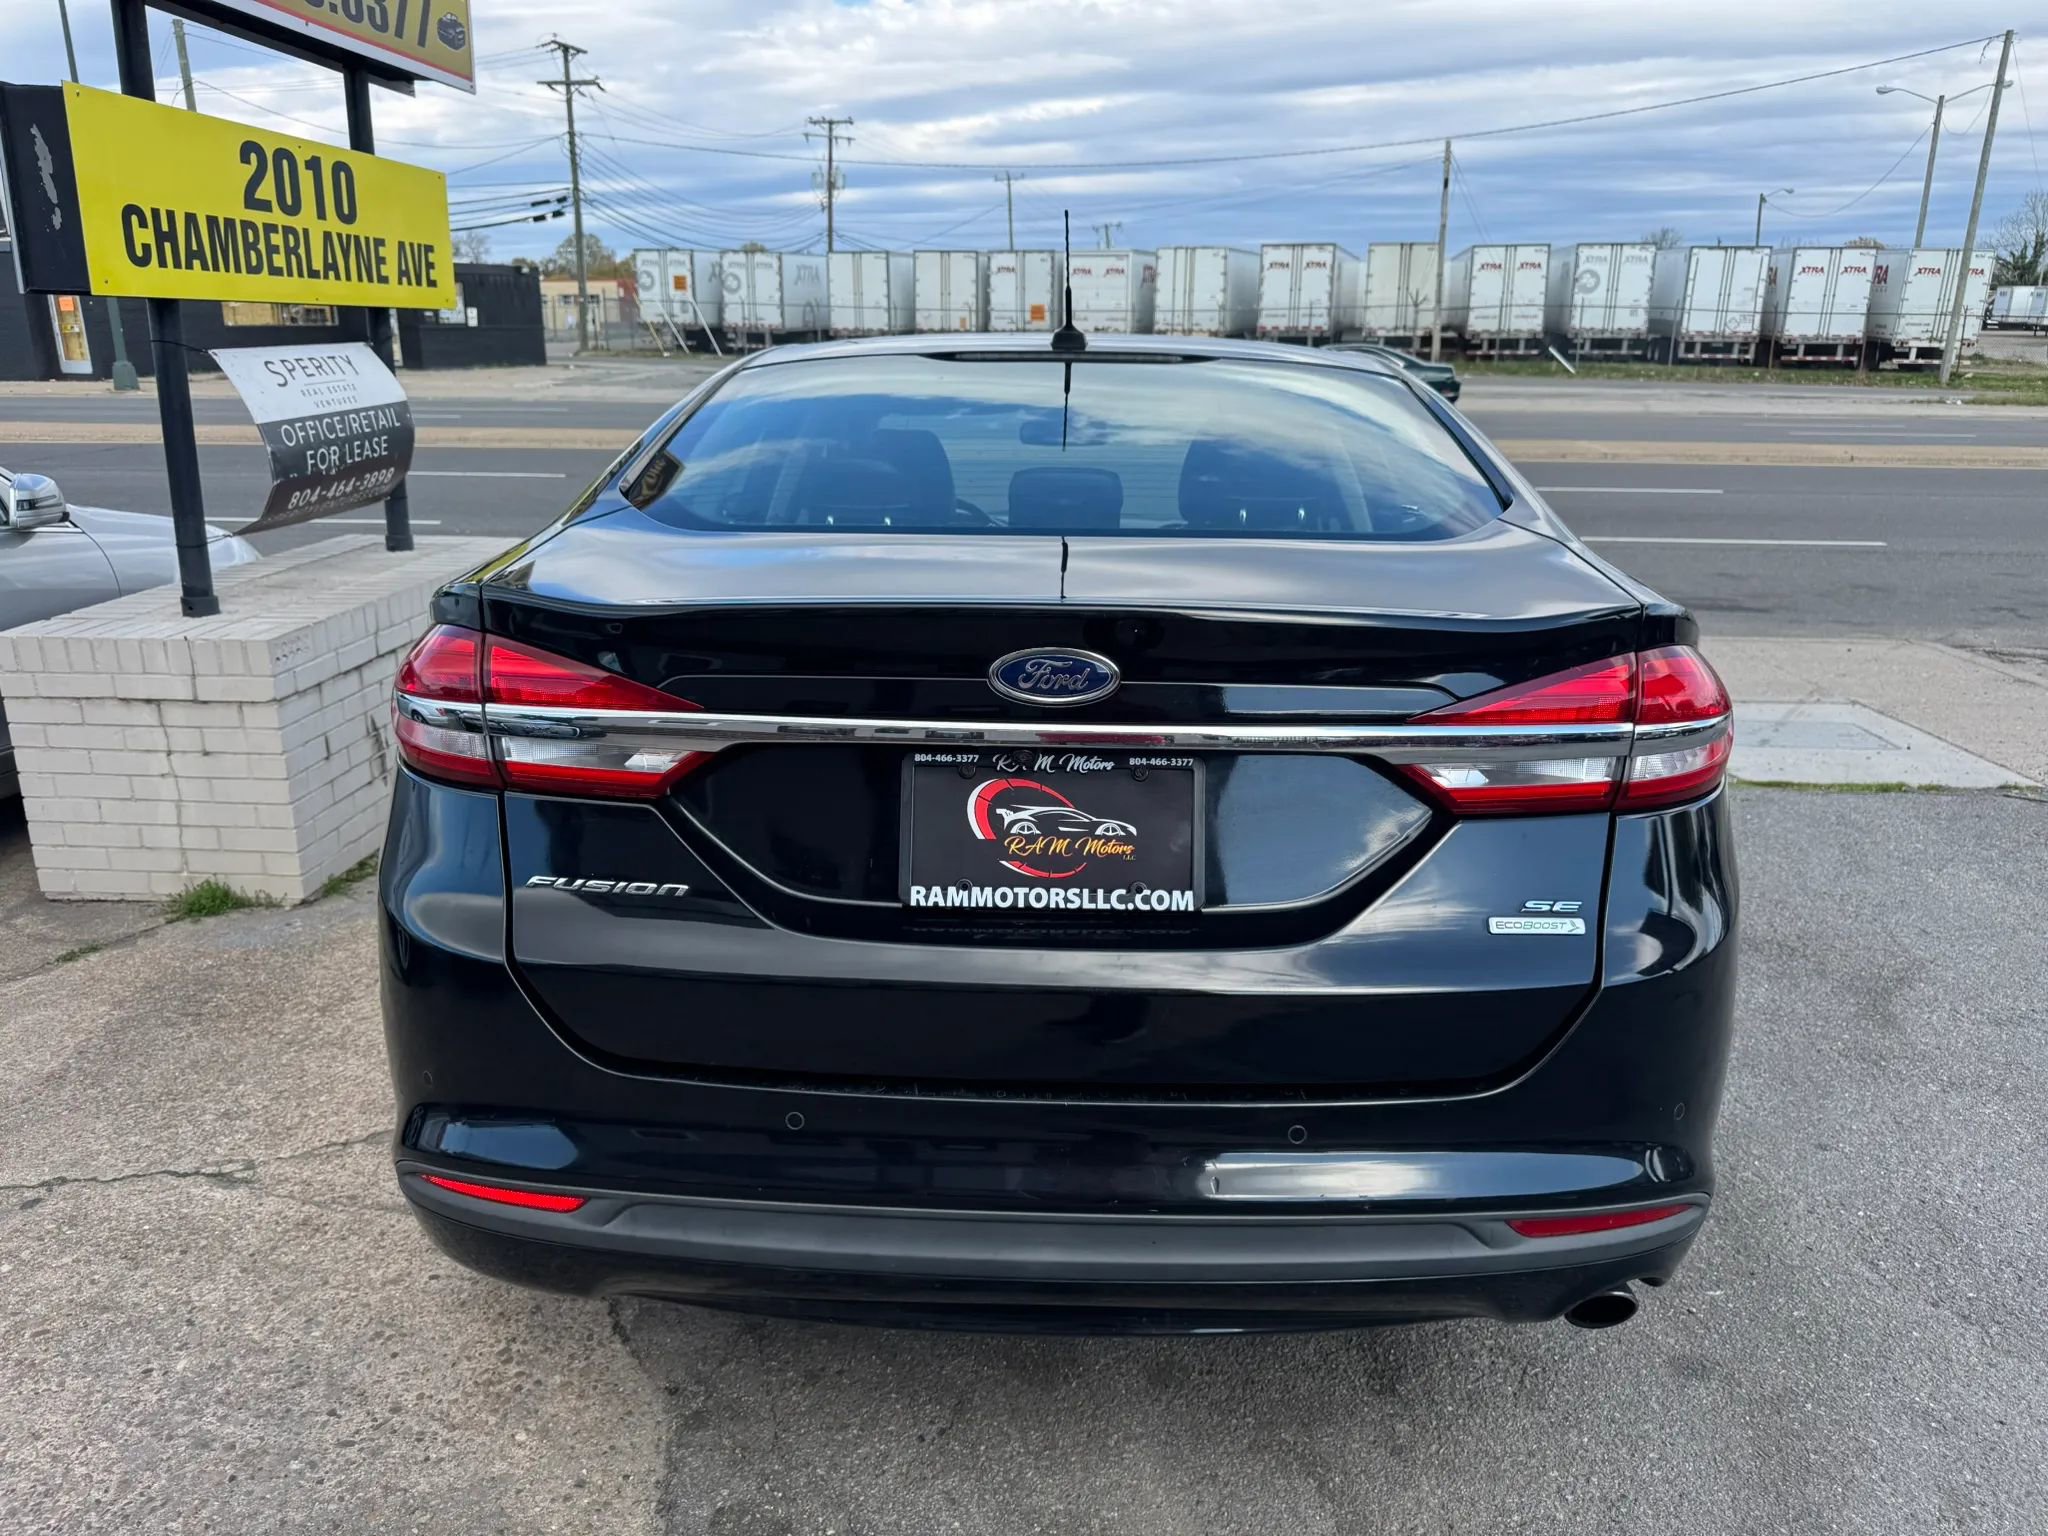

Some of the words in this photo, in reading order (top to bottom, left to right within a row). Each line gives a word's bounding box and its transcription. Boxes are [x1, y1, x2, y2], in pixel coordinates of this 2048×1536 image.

[239, 140, 358, 226] 2010
[121, 203, 390, 285] CHAMBERLAYNE
[397, 240, 438, 289] AVE
[1798, 265, 1825, 275] XTRA
[1841, 265, 1868, 275] XTRA
[1914, 266, 1942, 276] XTRA
[1967, 267, 1985, 276] TRA
[264, 354, 360, 388] SPERITY
[281, 407, 401, 447] OFFICE/RETAIL
[306, 446, 340, 473] FOR
[346, 436, 389, 464] LEASE
[288, 467, 395, 510] 804-464-3898
[1018, 658, 1091, 690] Ford
[914, 753, 979, 763] 804-466-3377
[1059, 753, 1115, 774] Motors
[1129, 757, 1194, 766] 804-466-3377
[1004, 836, 1073, 857] RAM
[1075, 836, 1136, 858] Motors
[524, 875, 690, 897] FUSION
[909, 885, 1195, 912] RAMMOTORSLLC.COM
[1520, 900, 1583, 913] SE
[1495, 920, 1567, 930] ECOBOOST
